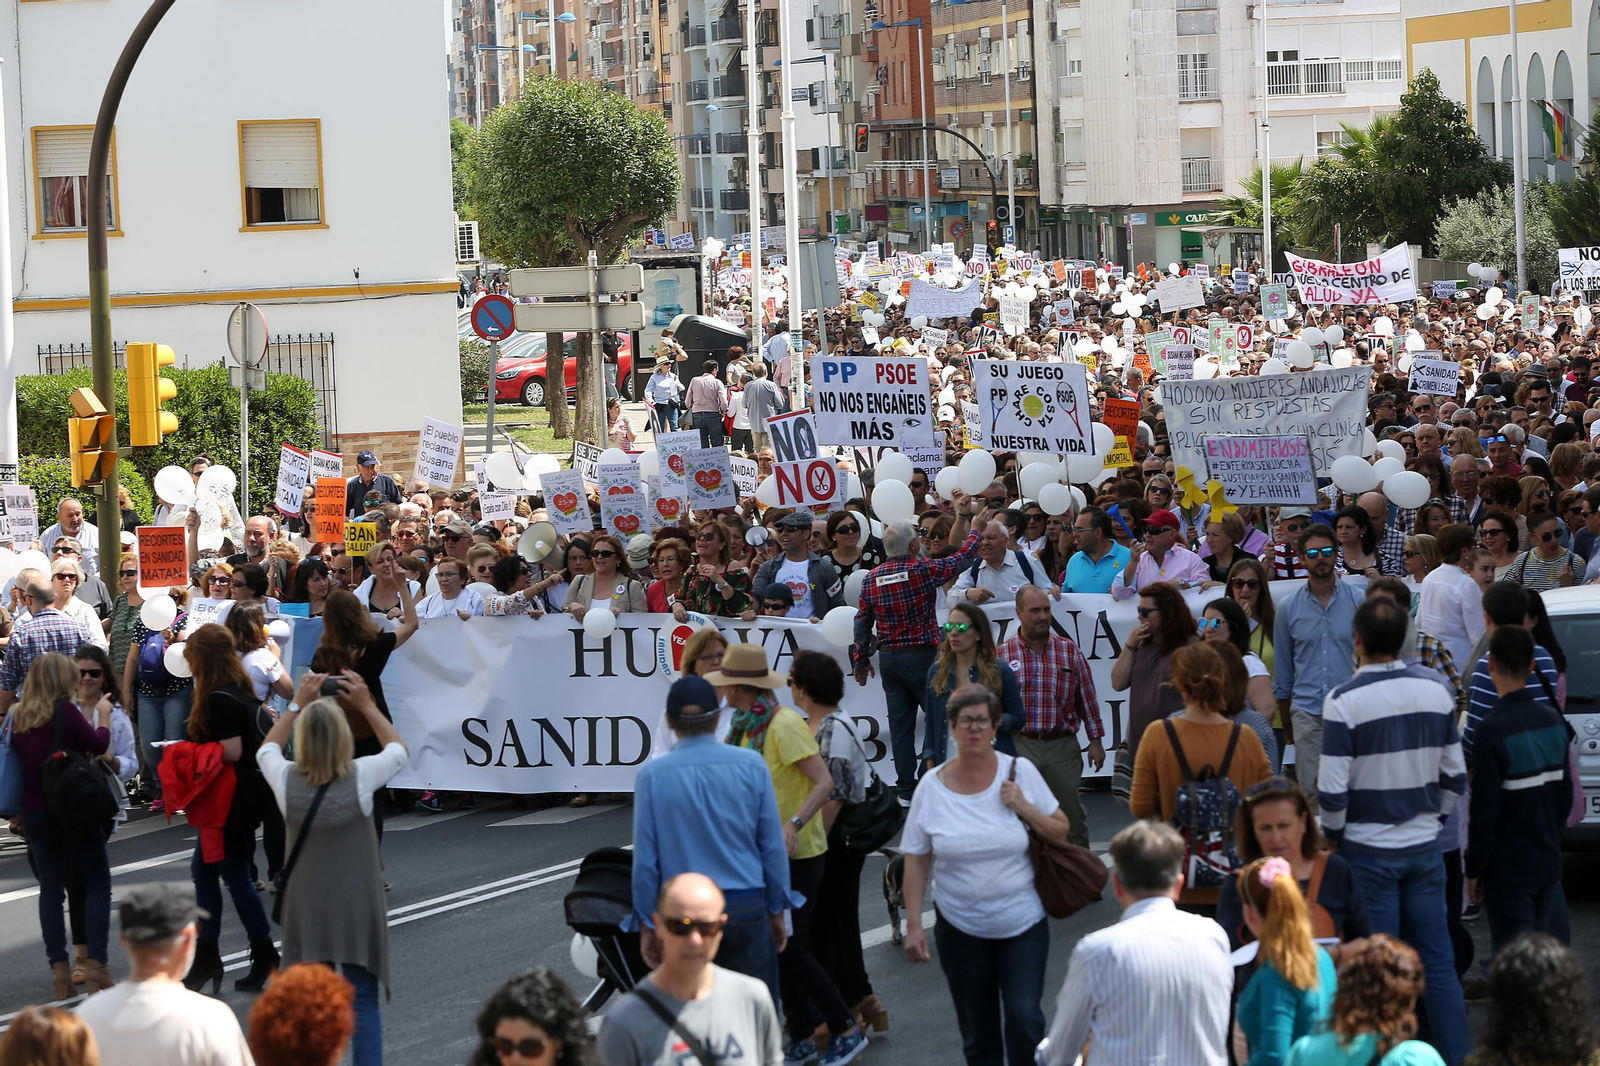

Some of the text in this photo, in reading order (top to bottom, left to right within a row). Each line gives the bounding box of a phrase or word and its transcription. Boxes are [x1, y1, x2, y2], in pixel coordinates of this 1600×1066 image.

[1007, 229, 1013, 240] P
[1579, 247, 1600, 261] NO
[907, 256, 922, 269] NO
[966, 262, 984, 275] NO
[1016, 259, 1032, 270] NO
[732, 273, 747, 285] NO
[1066, 269, 1081, 290] NO
[1274, 273, 1295, 289] NO
[1332, 274, 1388, 289] CENTRO
[1391, 267, 1411, 283] DE
[1562, 279, 1568, 291] A
[1571, 277, 1585, 290] LOS
[1303, 286, 1343, 302] ALUD
[822, 361, 917, 385] PP PSOE
[990, 364, 1064, 380] SU JUEGO
[1231, 375, 1296, 400] MUJERES
[819, 388, 927, 416] NO NOS ENGAÑEIS
[990, 388, 1074, 404] PP PSOE
[1104, 405, 1139, 421] RECORTES
[1233, 397, 1332, 420] RESPUESTAS
[434, 429, 459, 444] pueblo
[850, 416, 895, 441] MÁS
[1112, 422, 1136, 438] SANIDAD
[660, 435, 698, 444] VILLABLANCA
[991, 435, 1087, 453] NUESTRA VIDA
[421, 439, 457, 457] reclama:
[577, 445, 587, 457] SE
[685, 449, 726, 458] VILLABLANCA
[1207, 437, 1308, 459] ENDOMETRIOSIS
[419, 451, 454, 470] Susana
[906, 453, 943, 463] eclama:
[417, 464, 452, 484] NO sana!
[584, 461, 598, 480] SAL
[731, 463, 757, 478] ANIDAD,
[774, 460, 837, 506] NO
[1225, 484, 1301, 499] #YEAHHHH
[139, 533, 184, 547] RECORTES
[345, 526, 375, 541] OBAN
[140, 551, 184, 564] EN SANIDAD
[141, 567, 186, 581] MATAN.
[672, 634, 687, 647] YEA
[568, 627, 804, 679] HUVA
[461, 715, 652, 768] SANID
